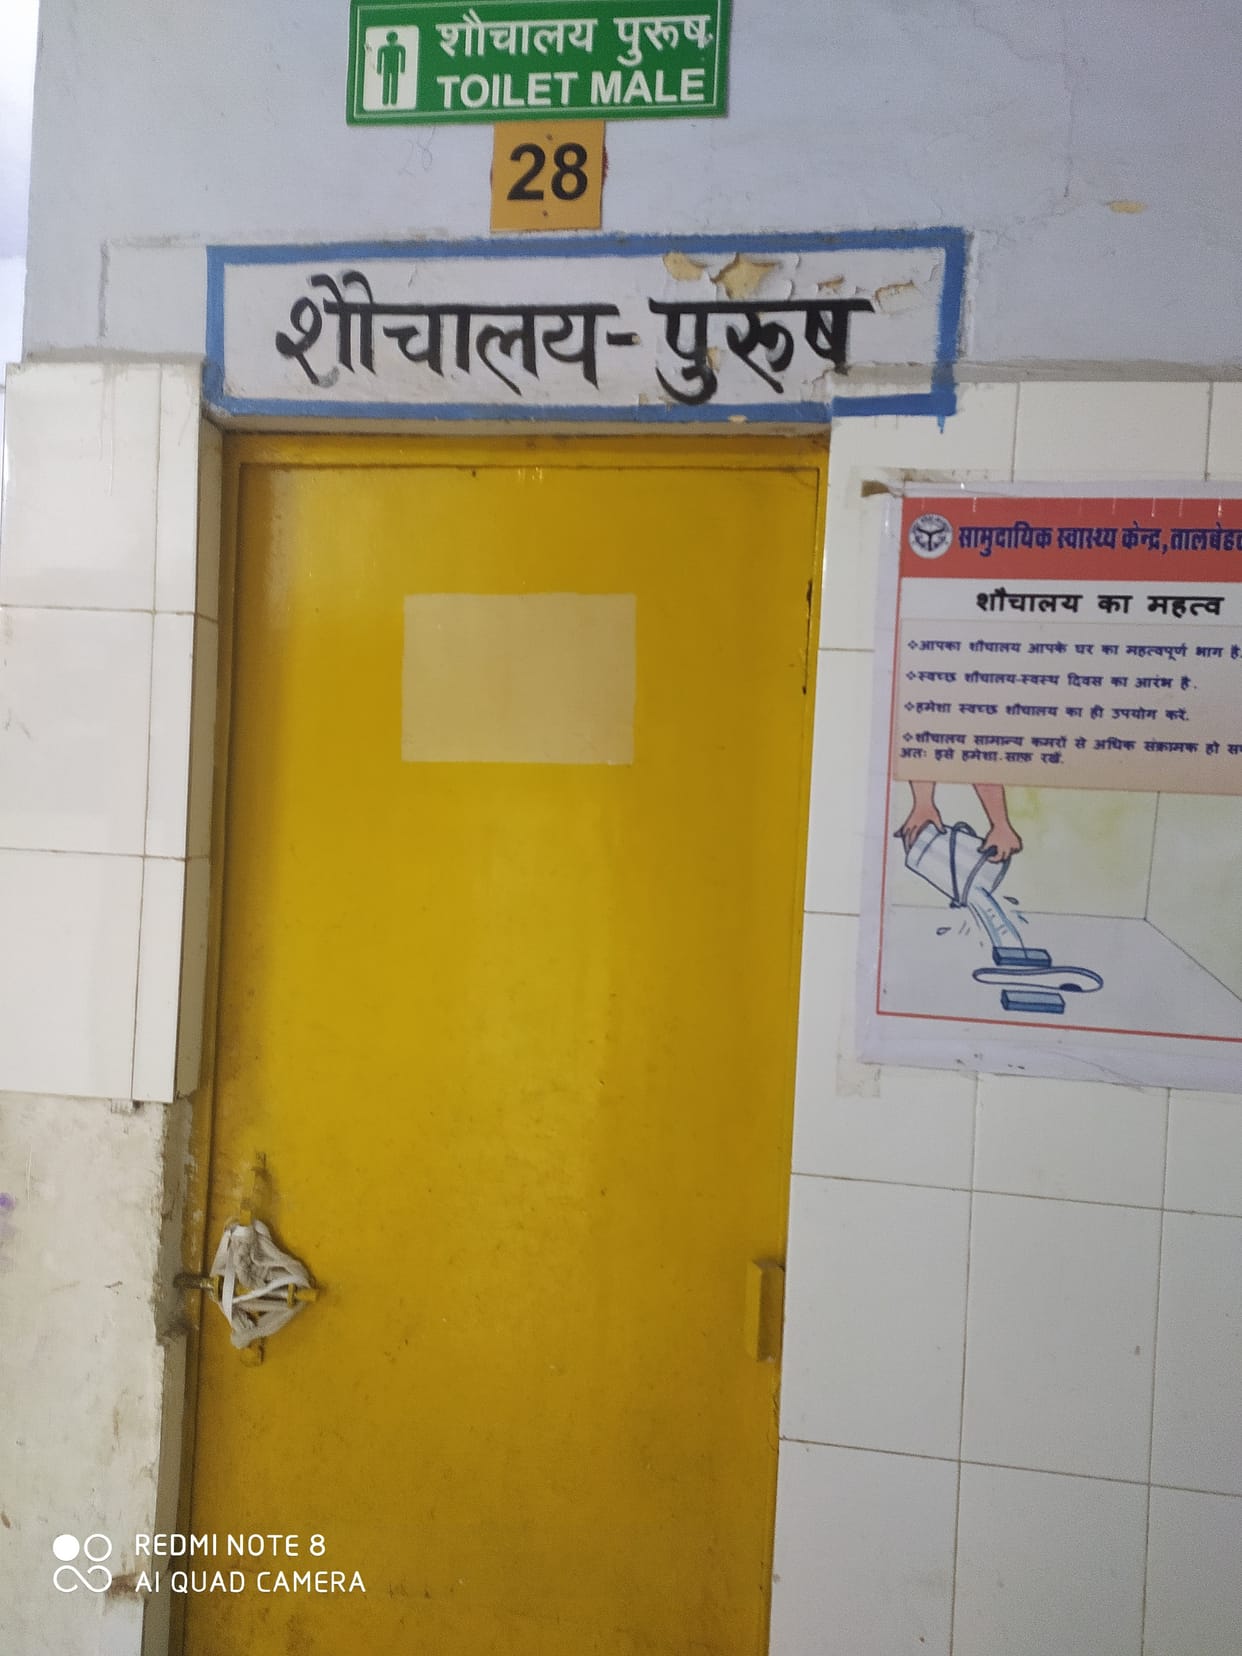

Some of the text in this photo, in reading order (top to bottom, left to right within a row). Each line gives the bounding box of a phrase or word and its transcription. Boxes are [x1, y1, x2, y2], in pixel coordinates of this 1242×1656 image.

[435, 9, 598, 57] शौचालय
[437, 68, 706, 109] TOILET MALE
[507, 142, 588, 201] 28
[958, 520, 1052, 557] सामुदायिक
[1057, 527, 1118, 549] स्वास्थ्य
[976, 587, 1224, 618] शौचालय का महत्व
[918, 640, 961, 652] आपका
[969, 639, 1022, 653] शौचालय
[1027, 641, 1068, 654] आपके
[1074, 643, 1094, 655] घर
[1101, 644, 1120, 656] का
[1125, 642, 1188, 661] महत्वपूर्ण
[1195, 645, 1225, 658] भाग
[918, 671, 957, 683] स्वच्छ
[1067, 672, 1104, 687] दिवस
[1110, 675, 1129, 688] का
[1135, 675, 1174, 689] आरंभ
[915, 700, 952, 714] हमेशा
[958, 702, 998, 715] स्वच्छ
[1005, 703, 1059, 717] शौचालय
[1065, 706, 1083, 718] का
[1090, 703, 1104, 720] ही
[1111, 706, 1158, 720] उपयोग
[915, 730, 967, 745] शौचालय
[973, 734, 1024, 747] सामान्य
[1074, 736, 1087, 749] से
[1093, 736, 1136, 751] अधिक
[1205, 740, 1220, 756] हो
